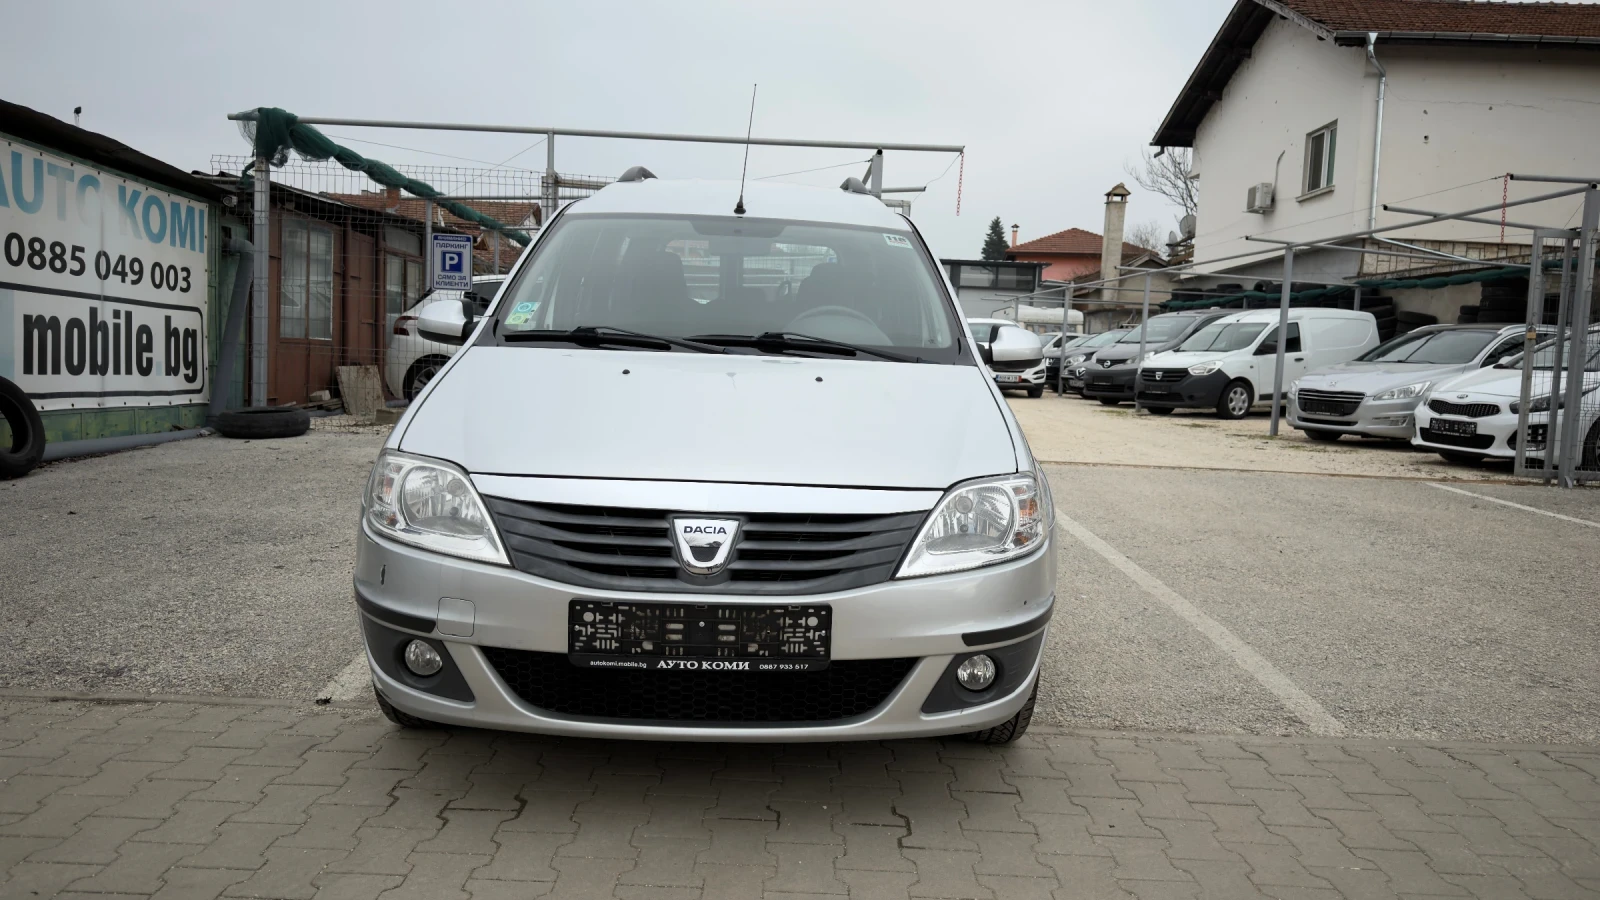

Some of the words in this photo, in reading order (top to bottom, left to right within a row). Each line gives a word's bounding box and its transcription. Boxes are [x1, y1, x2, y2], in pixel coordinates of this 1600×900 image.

[118, 184, 205, 254] KOMI
[4, 232, 86, 277] 0885
[94, 250, 144, 286] 049
[150, 261, 192, 294] 003
[445, 253, 459, 271] P
[436, 280, 468, 288] КЛИЕНТИ
[22, 306, 198, 384] mobile.bg
[684, 526, 727, 535] DACIA
[589, 660, 647, 669] autokomi.mobile.bg
[657, 660, 699, 670] АУТО
[701, 661, 750, 670] КОМИ
